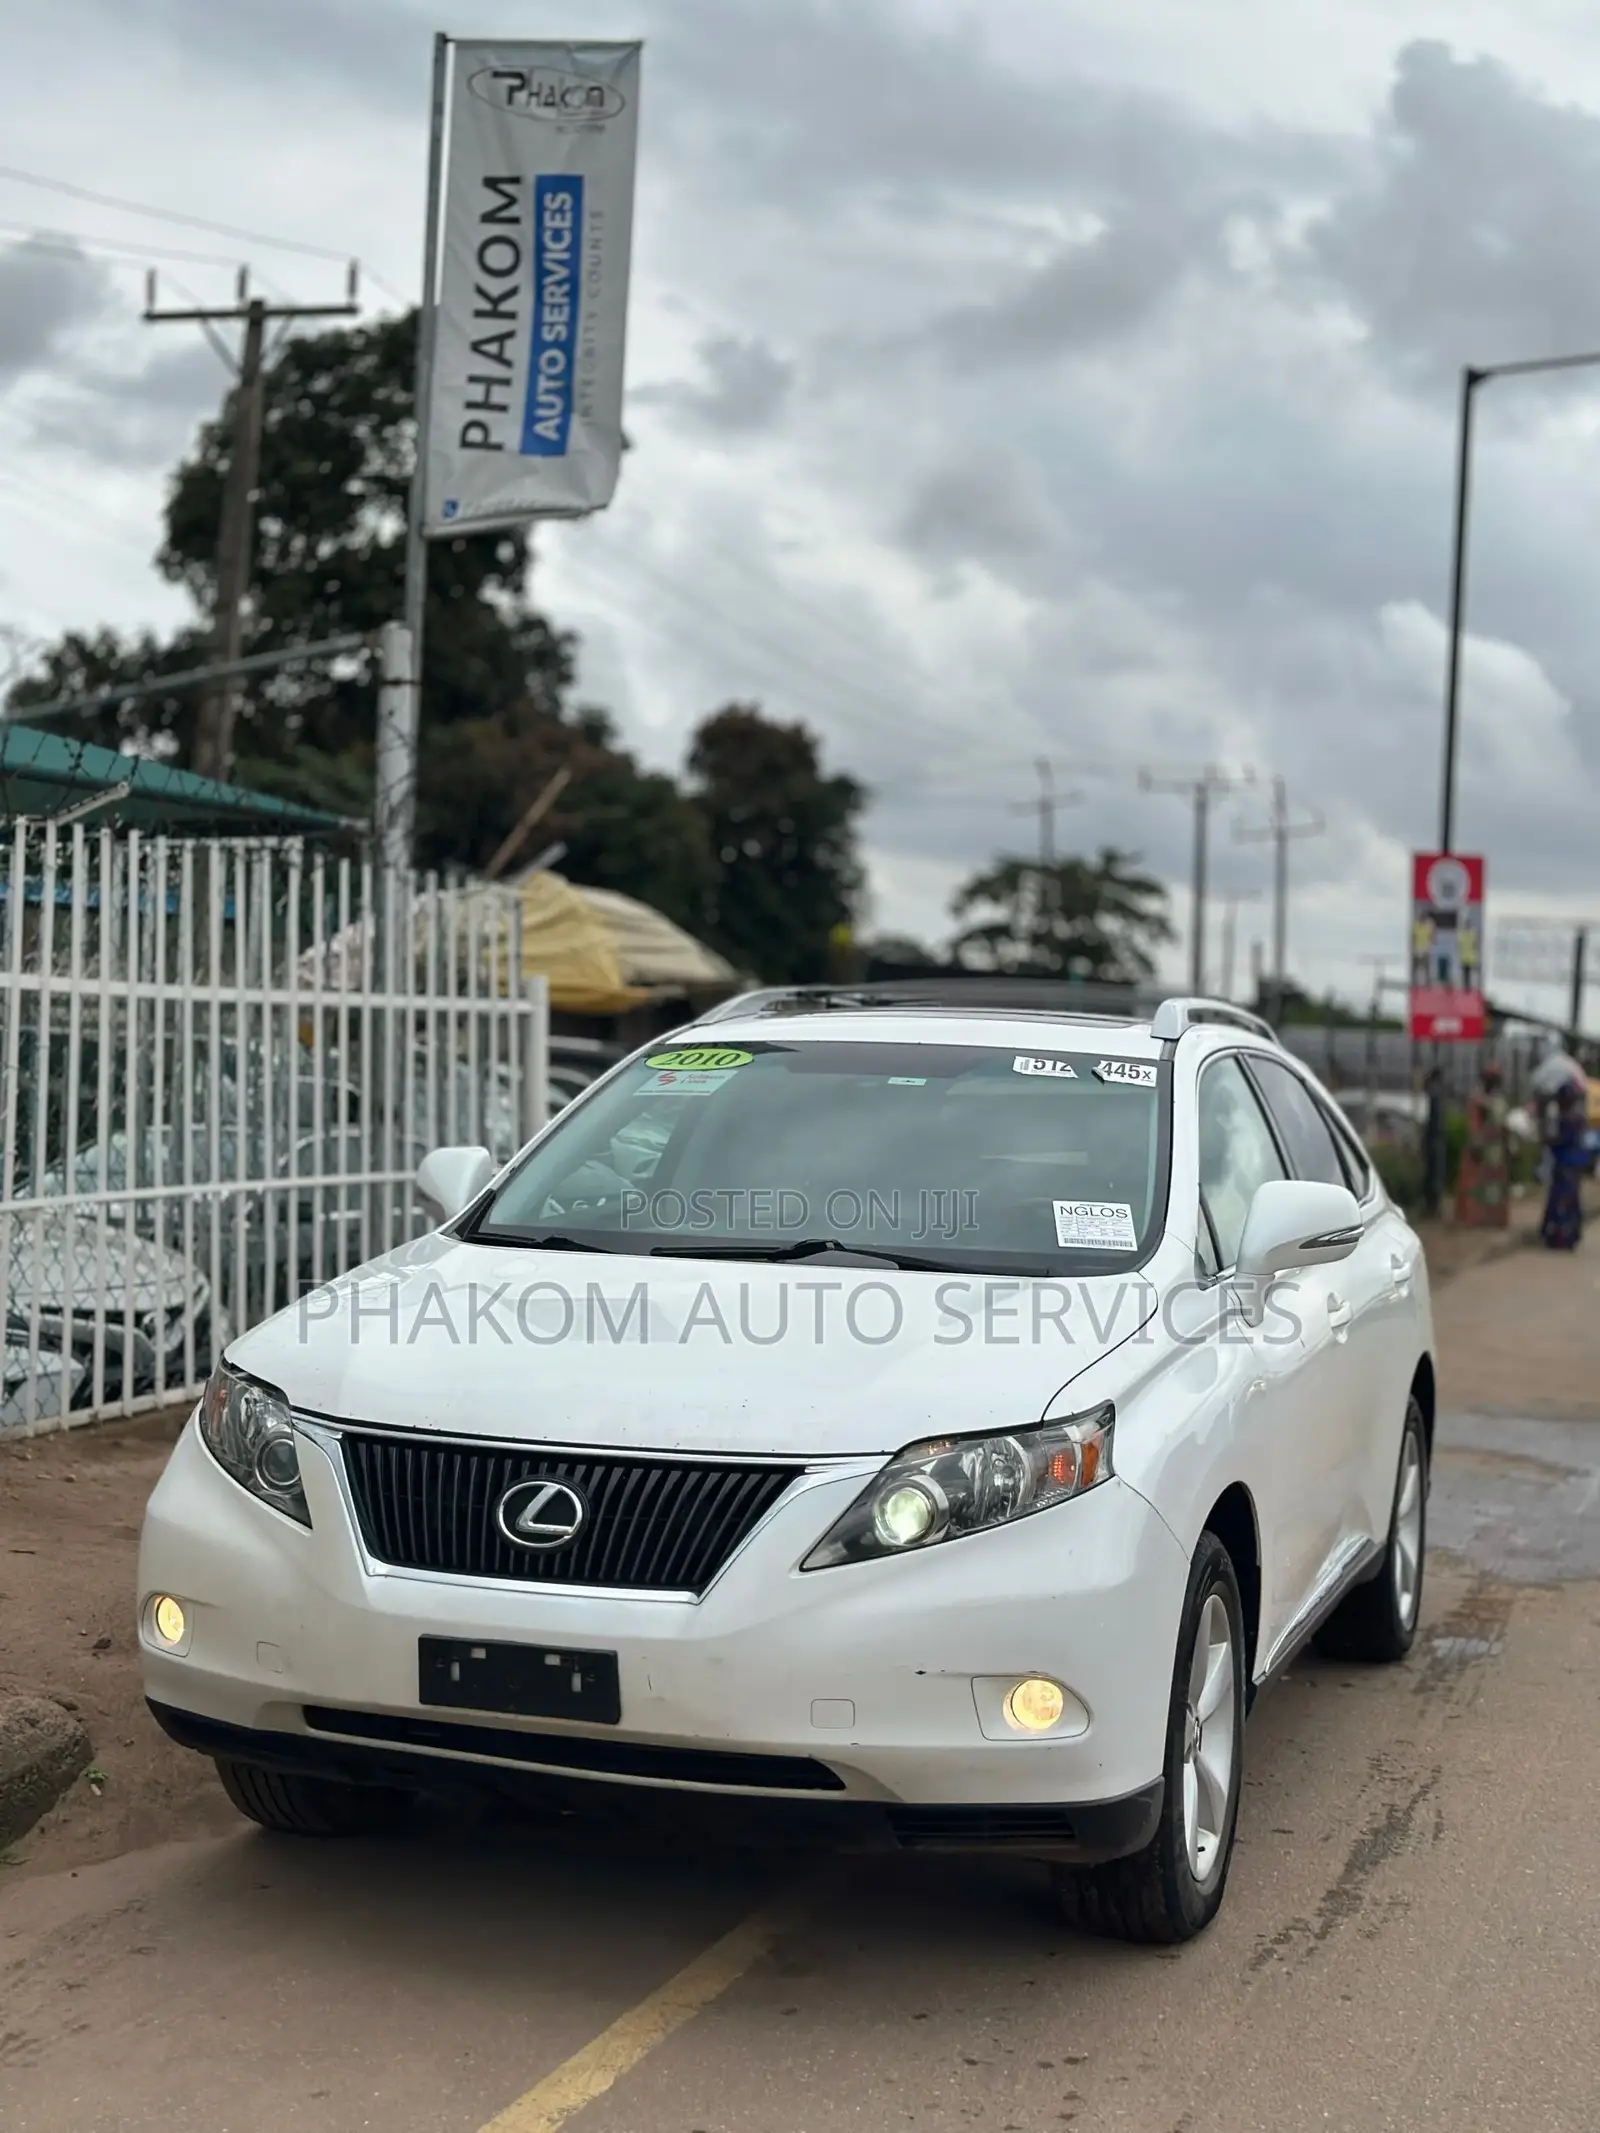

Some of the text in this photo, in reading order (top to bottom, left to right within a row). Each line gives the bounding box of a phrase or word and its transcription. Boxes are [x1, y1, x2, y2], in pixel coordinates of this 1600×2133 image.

[459, 175, 522, 451] PHAKOM
[533, 191, 574, 441] AUTO SERVICES
[655, 1052, 741, 1067] 2010
[1060, 1206, 1128, 1219] NGLOS
